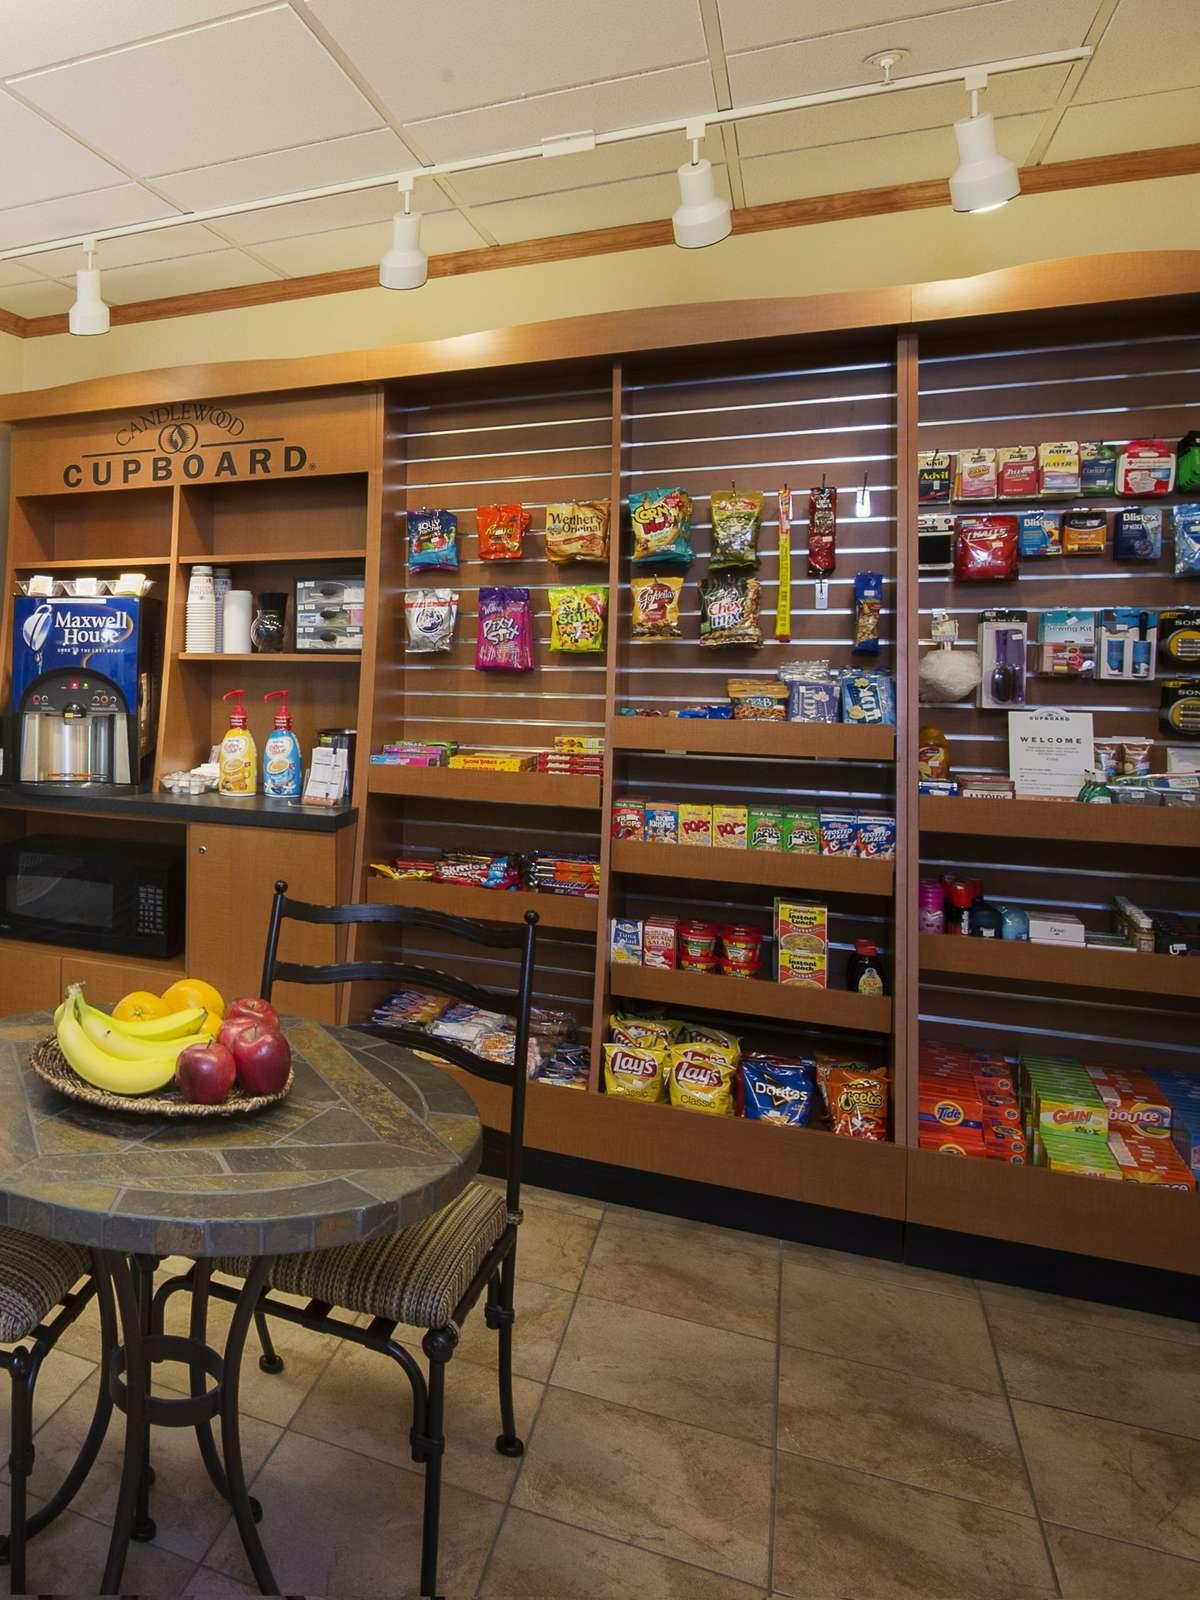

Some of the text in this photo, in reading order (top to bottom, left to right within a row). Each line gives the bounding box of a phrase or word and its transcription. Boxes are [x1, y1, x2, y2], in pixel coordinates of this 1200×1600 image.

[116, 403, 245, 446] CANDLEWOOD
[922, 470, 949, 480] Advil
[634, 503, 670, 524] CORN
[1123, 513, 1159, 522] Blistex
[418, 519, 441, 531] JOLLY
[1024, 518, 1056, 528] Blistex
[972, 529, 1007, 539] HALLS
[708, 598, 743, 616] Chex
[55, 611, 128, 629] Maxwell
[1079, 623, 1092, 632] Kit
[62, 628, 120, 646] House
[1020, 736, 1082, 744] WELCOME
[682, 819, 711, 835] POPS
[789, 913, 817, 922] Instant
[792, 918, 814, 926] Lunch
[789, 959, 817, 967] Instant
[792, 963, 814, 971] Lunch
[614, 1052, 655, 1075] Lay's
[678, 1062, 719, 1085] Lay's
[755, 1081, 809, 1101] Doritos
[681, 1094, 716, 1109] Classic
[839, 1089, 883, 1111] Cheetos
[937, 1106, 961, 1120] Tide
[1109, 1108, 1160, 1124] bounce
